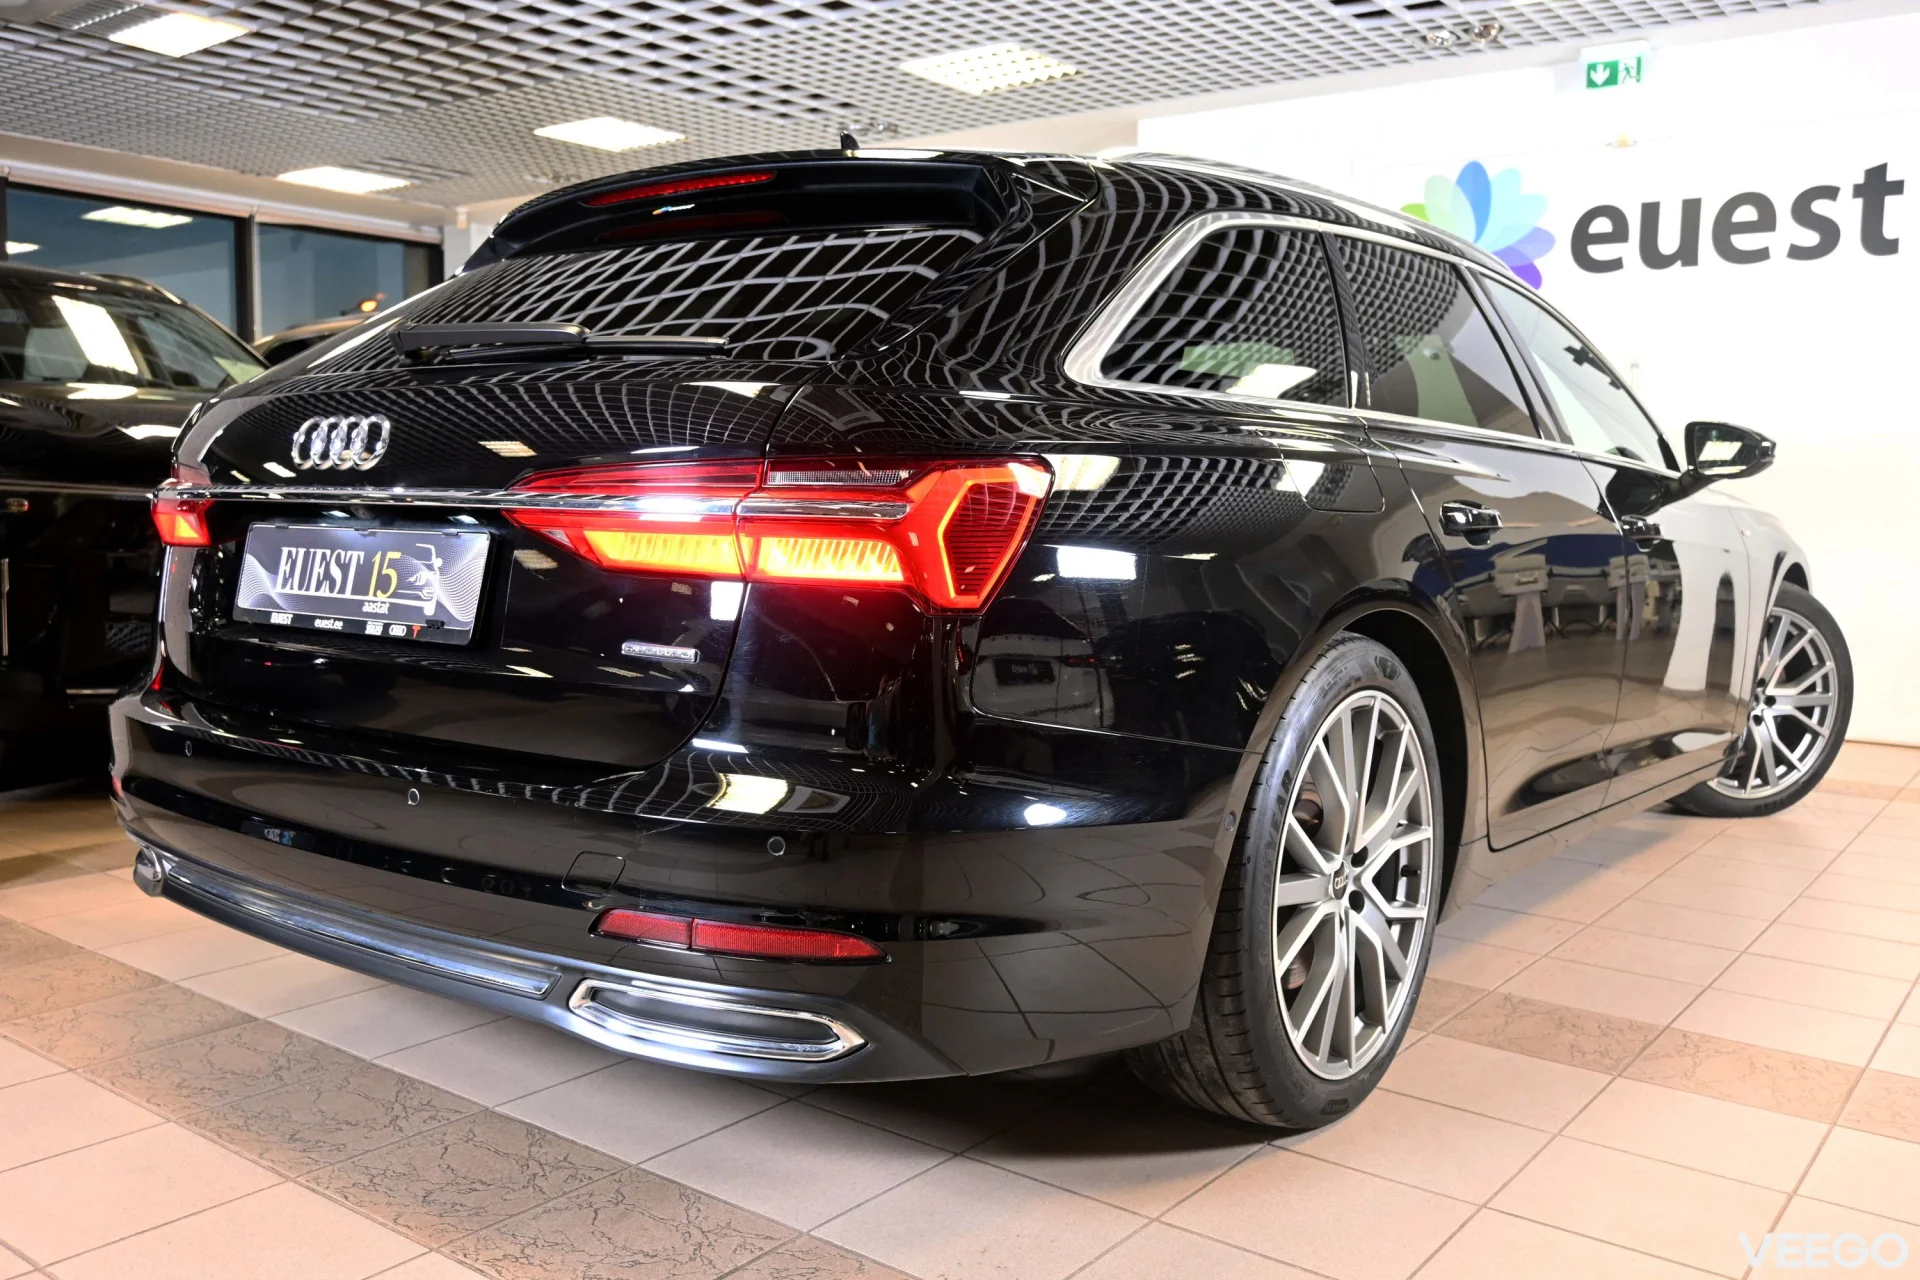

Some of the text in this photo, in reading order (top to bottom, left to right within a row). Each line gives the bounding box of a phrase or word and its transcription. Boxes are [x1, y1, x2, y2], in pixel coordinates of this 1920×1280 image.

[1570, 162, 1905, 275] euest
[274, 546, 402, 599] EUEST 15
[314, 618, 344, 631] euest.ee
[362, 600, 390, 615] aastat
